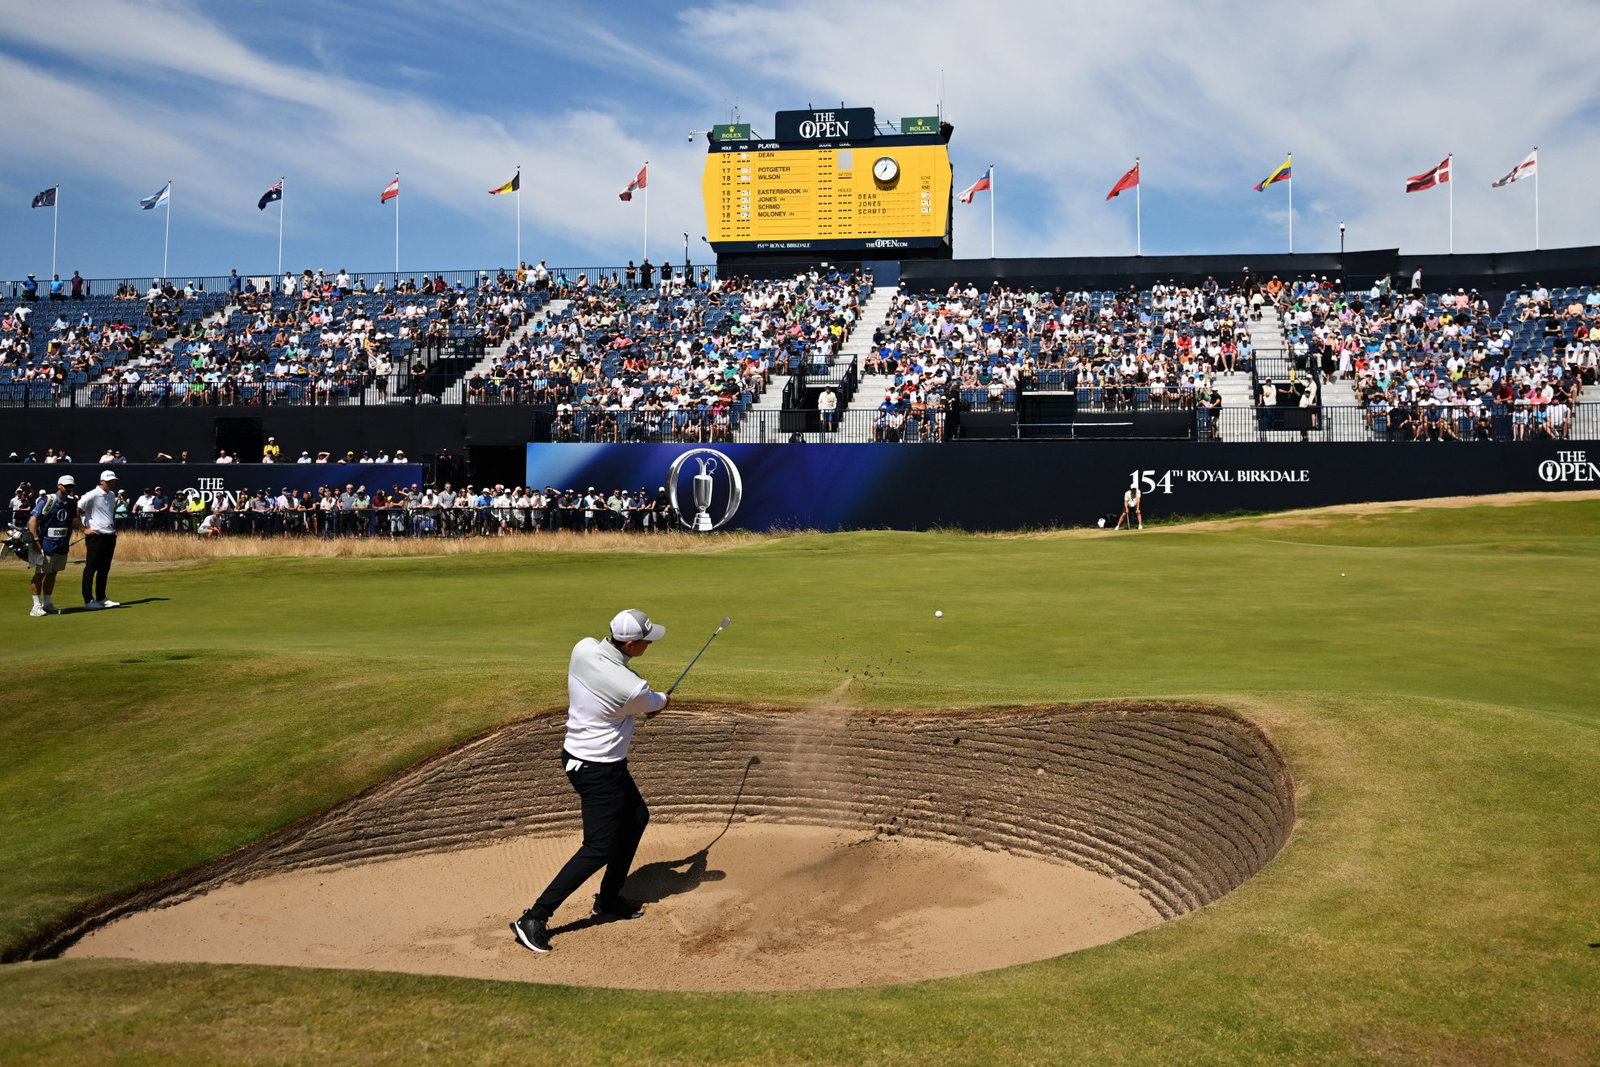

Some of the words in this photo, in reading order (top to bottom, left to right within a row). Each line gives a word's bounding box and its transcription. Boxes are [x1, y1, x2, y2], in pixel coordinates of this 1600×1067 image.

[813, 112, 835, 122] THE
[799, 120, 850, 139] OPEN
[1556, 450, 1587, 462] THE
[1187, 470, 1234, 482] ROYAL
[1237, 470, 1310, 482] BIRKDALE
[198, 478, 224, 490] THE
